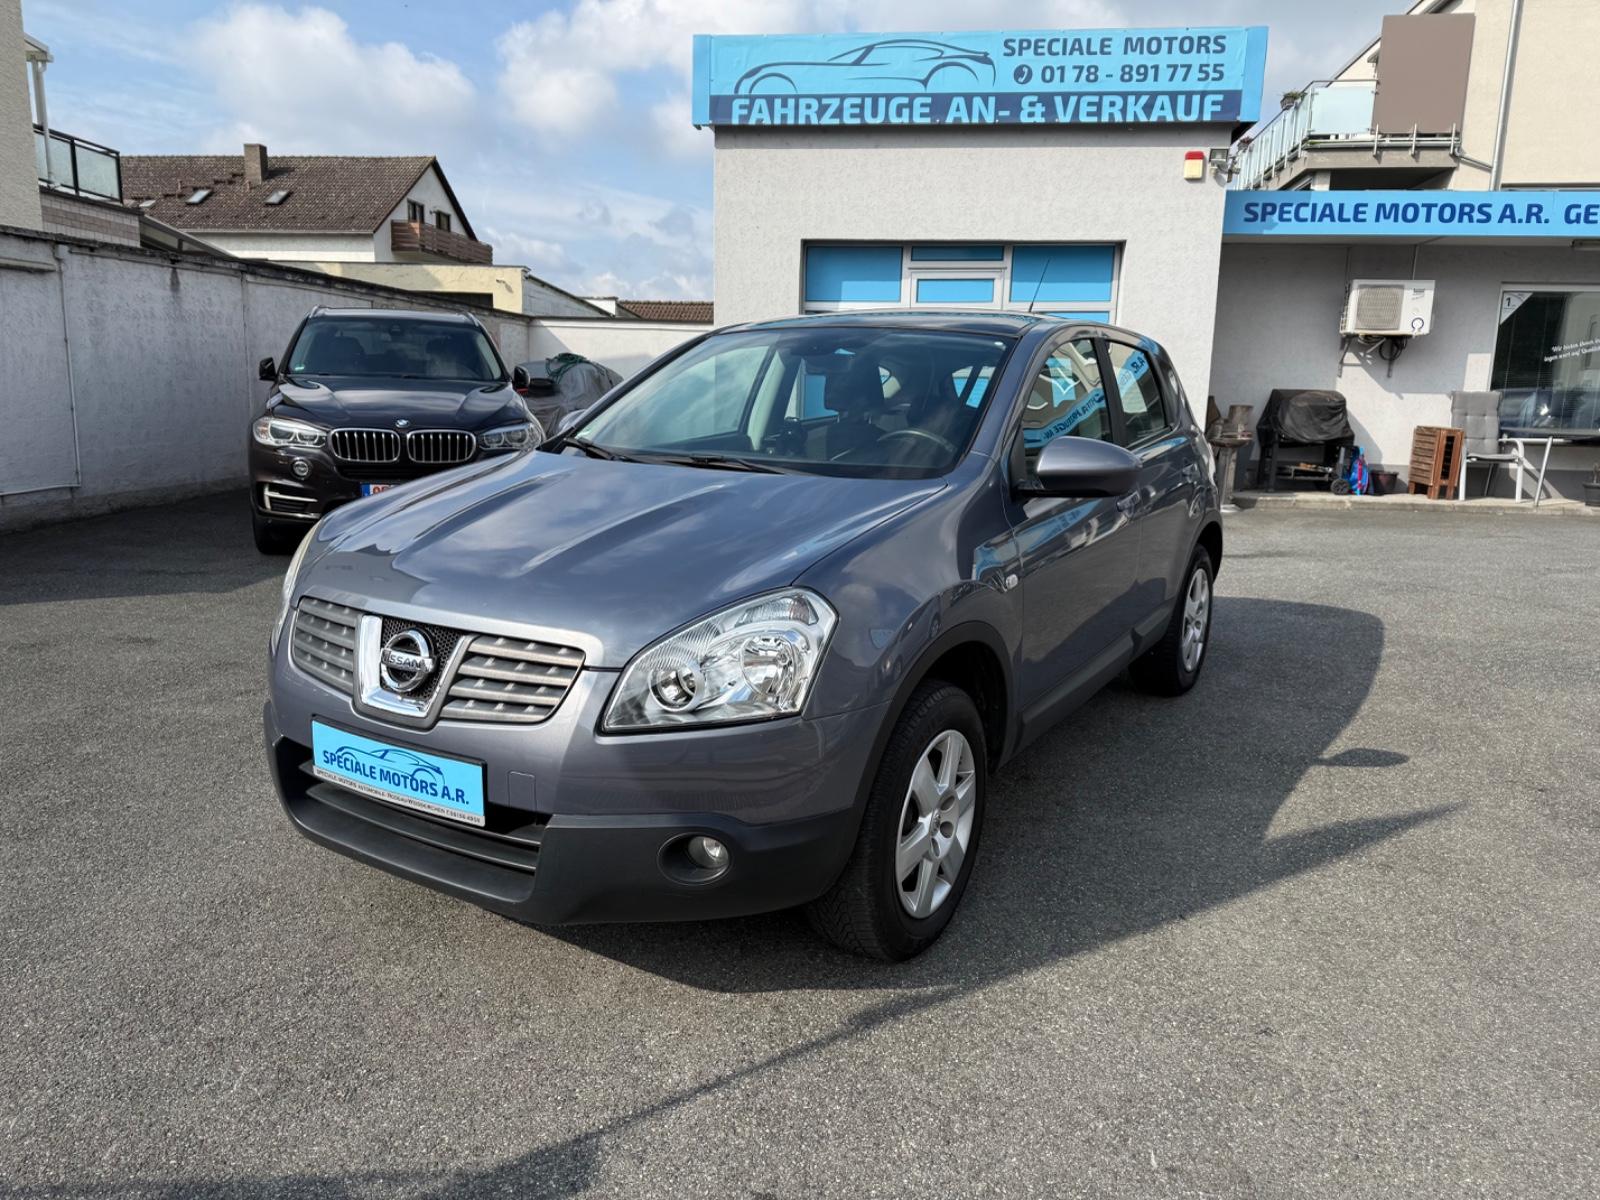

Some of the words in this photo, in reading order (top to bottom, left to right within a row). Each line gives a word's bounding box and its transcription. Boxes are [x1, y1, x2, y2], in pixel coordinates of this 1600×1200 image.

[1003, 37, 1113, 57] SPECIALE
[1123, 35, 1227, 56] MOTORS
[731, 96, 932, 125] FAHRZEUGE
[1020, 94, 1046, 123] &
[1053, 93, 1225, 123] VERKAUF
[1243, 201, 1369, 223] SPECIALE
[1374, 202, 1493, 224] MOTORS
[1497, 203, 1550, 224] A.R.
[323, 750, 377, 780] SPECIALE
[379, 768, 438, 797] MOTORS
[441, 785, 470, 806] A.R.
